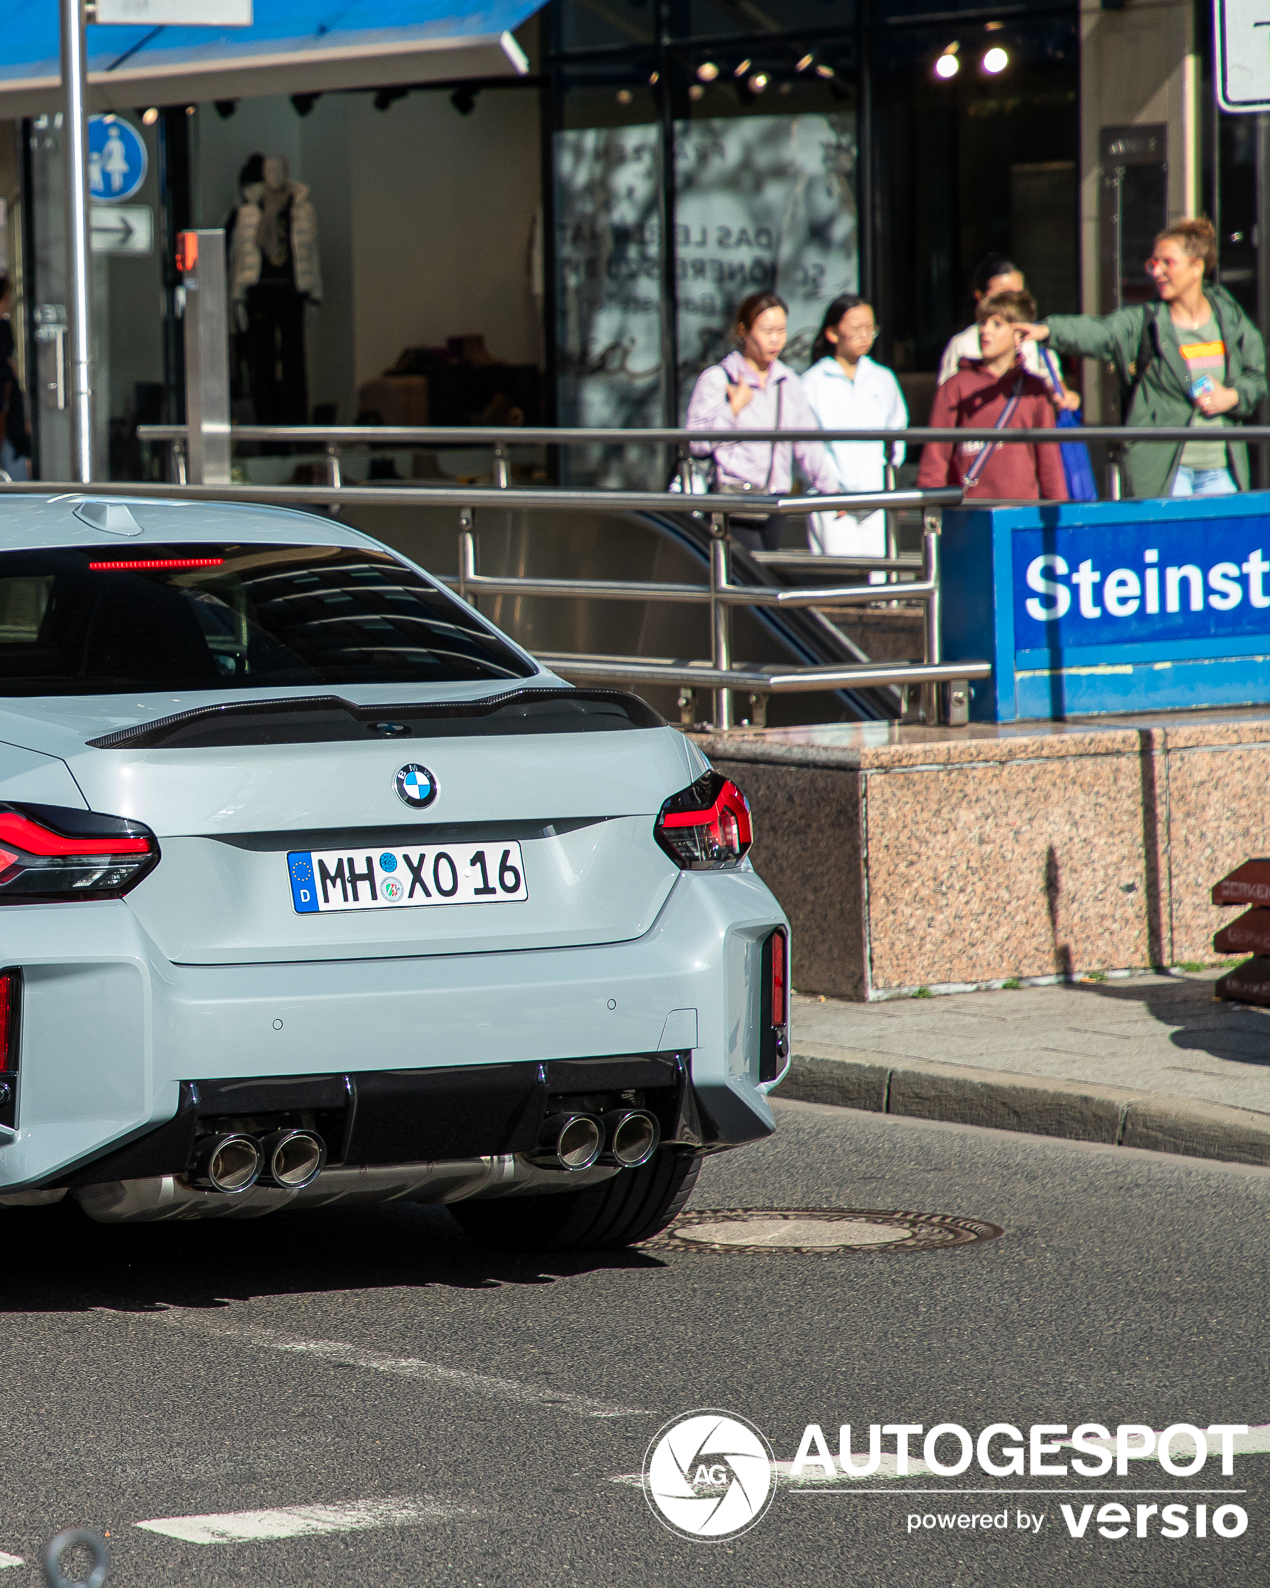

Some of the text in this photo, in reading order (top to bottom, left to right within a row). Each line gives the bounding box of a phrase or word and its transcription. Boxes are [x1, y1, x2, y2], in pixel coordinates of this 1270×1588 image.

[300, 889, 311, 903] D
[317, 855, 379, 903] MH
[470, 849, 522, 896] 16
